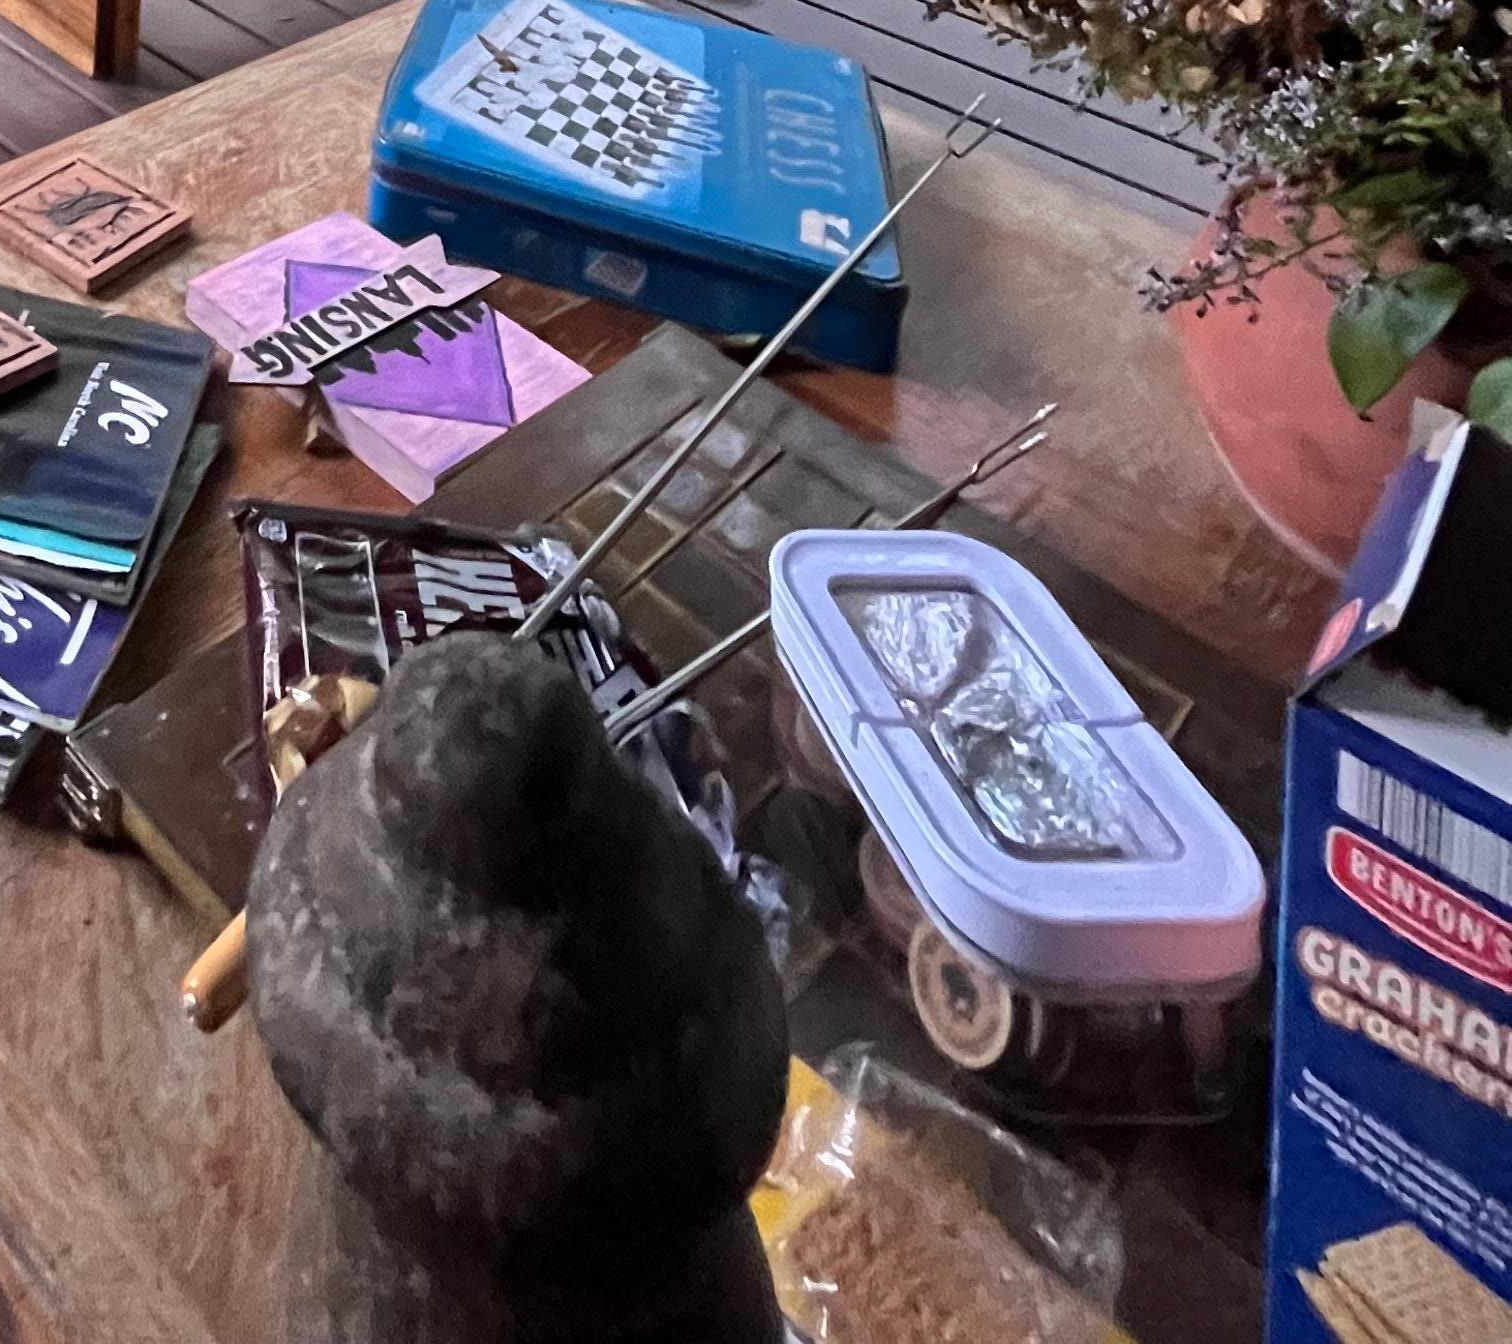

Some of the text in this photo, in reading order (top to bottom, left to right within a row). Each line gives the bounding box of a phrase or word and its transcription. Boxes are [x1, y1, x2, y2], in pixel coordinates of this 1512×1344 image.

[240, 264, 445, 379] LANSING
[97, 378, 169, 445] NC
[1350, 846, 1512, 968] BENTON'S
[1302, 929, 1512, 1079] GRAHA
[1316, 990, 1512, 1118] cracker
